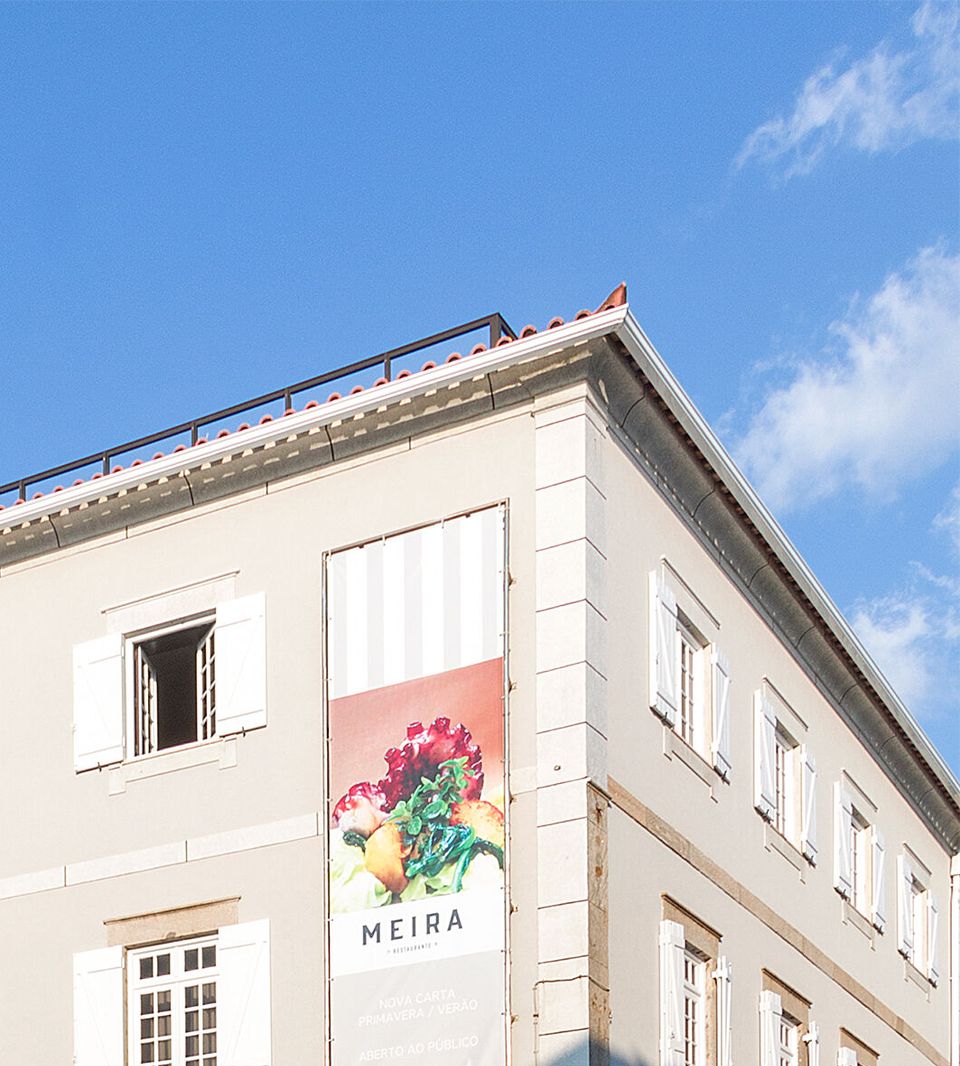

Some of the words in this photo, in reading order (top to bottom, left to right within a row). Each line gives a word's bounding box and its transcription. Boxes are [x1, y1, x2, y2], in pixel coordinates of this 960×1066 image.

[362, 908, 464, 946] MEIRA
[379, 994, 412, 1010] NOVA
[415, 988, 456, 1004] CARTA
[358, 1007, 424, 1028] PRIMAVERA
[359, 1045, 404, 1062] ABERTO
[407, 1041, 425, 1057] AO
[427, 1035, 480, 1053] PÚBLICO
